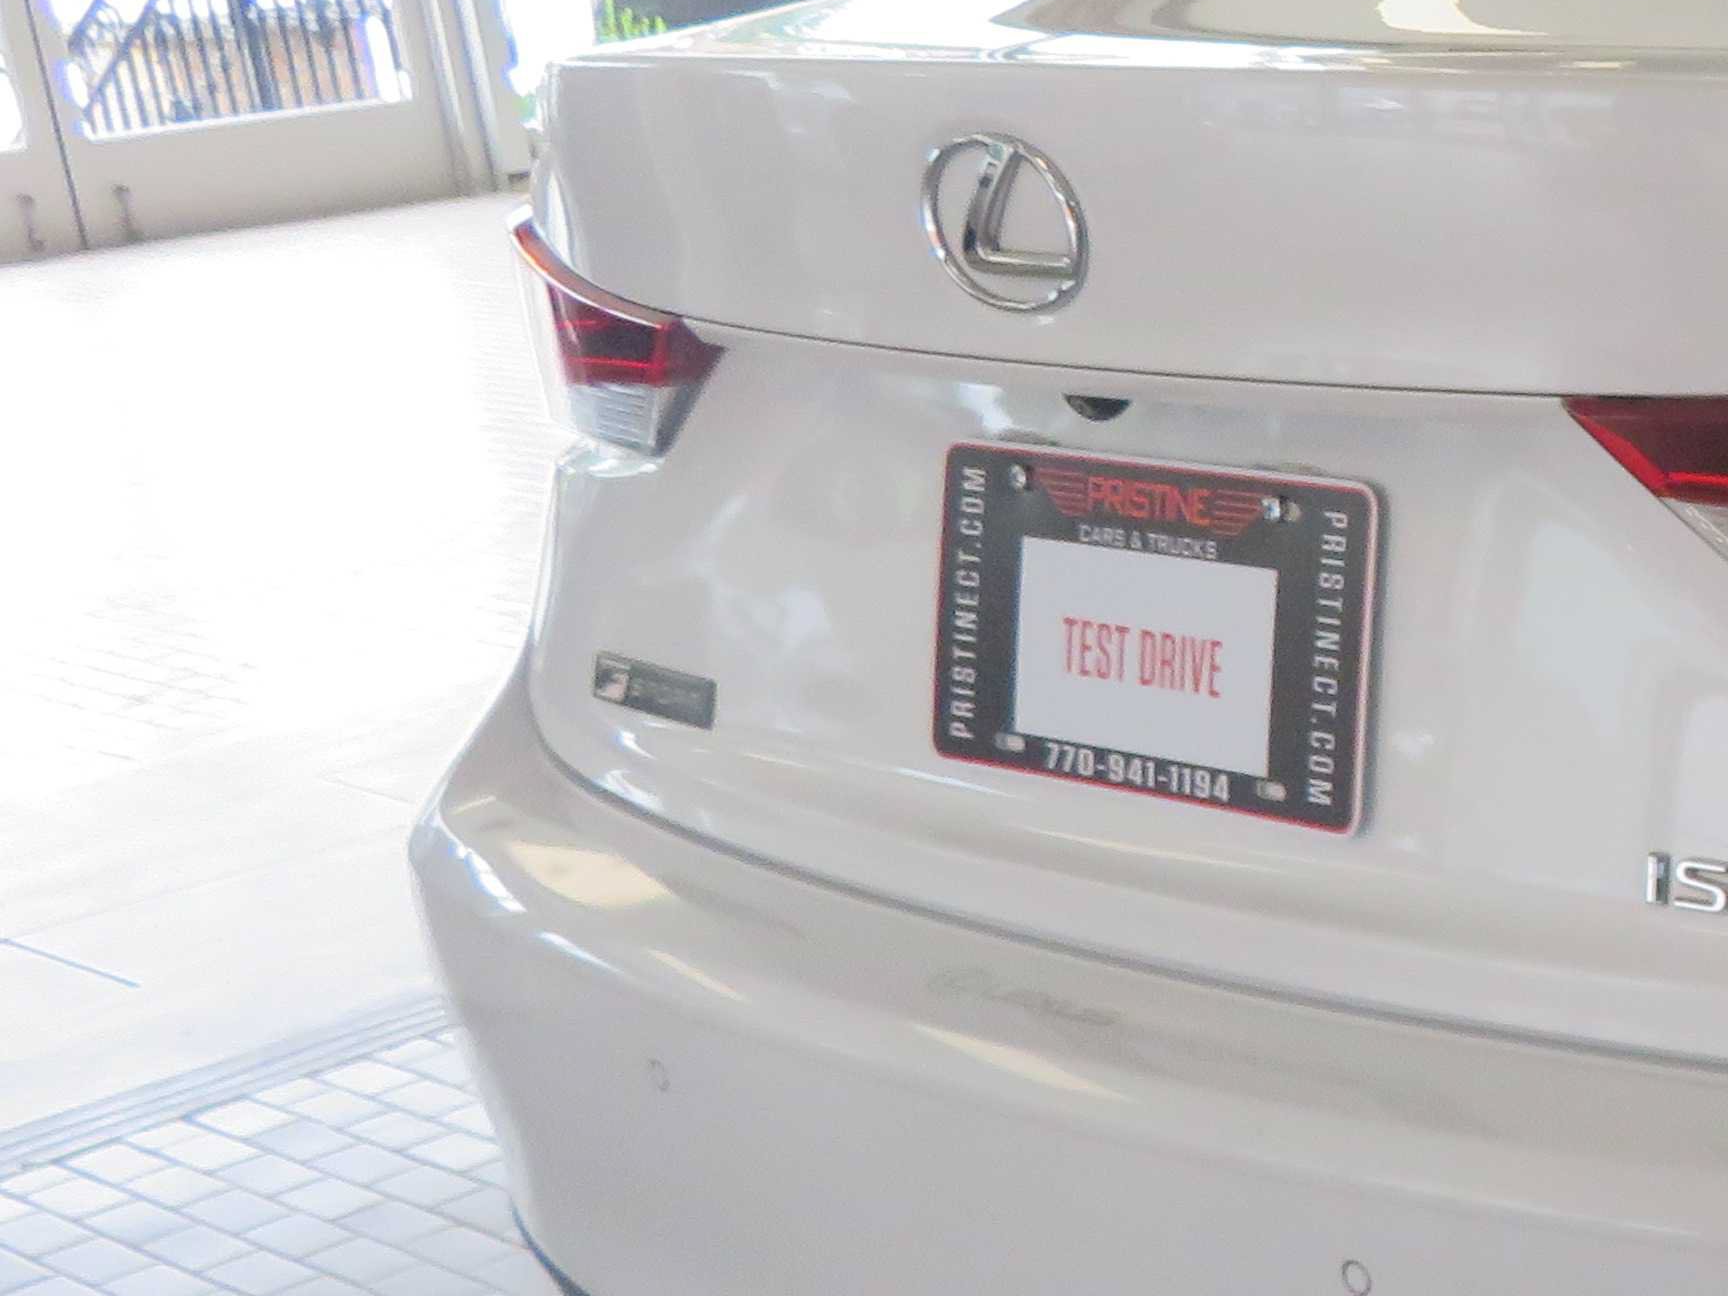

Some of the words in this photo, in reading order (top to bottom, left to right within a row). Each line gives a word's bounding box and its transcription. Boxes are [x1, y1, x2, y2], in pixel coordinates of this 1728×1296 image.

[1078, 525, 1124, 547] CARS
[1129, 531, 1142, 549] &
[1147, 532, 1217, 560] TRUCKS
[949, 467, 986, 738] PRISTINECT.COM
[1063, 617, 1129, 684] TEST
[1139, 629, 1223, 698] DRIVE
[1307, 511, 1348, 806] PRISTINECT.COM
[1044, 743, 1228, 802] 770-941-1194
